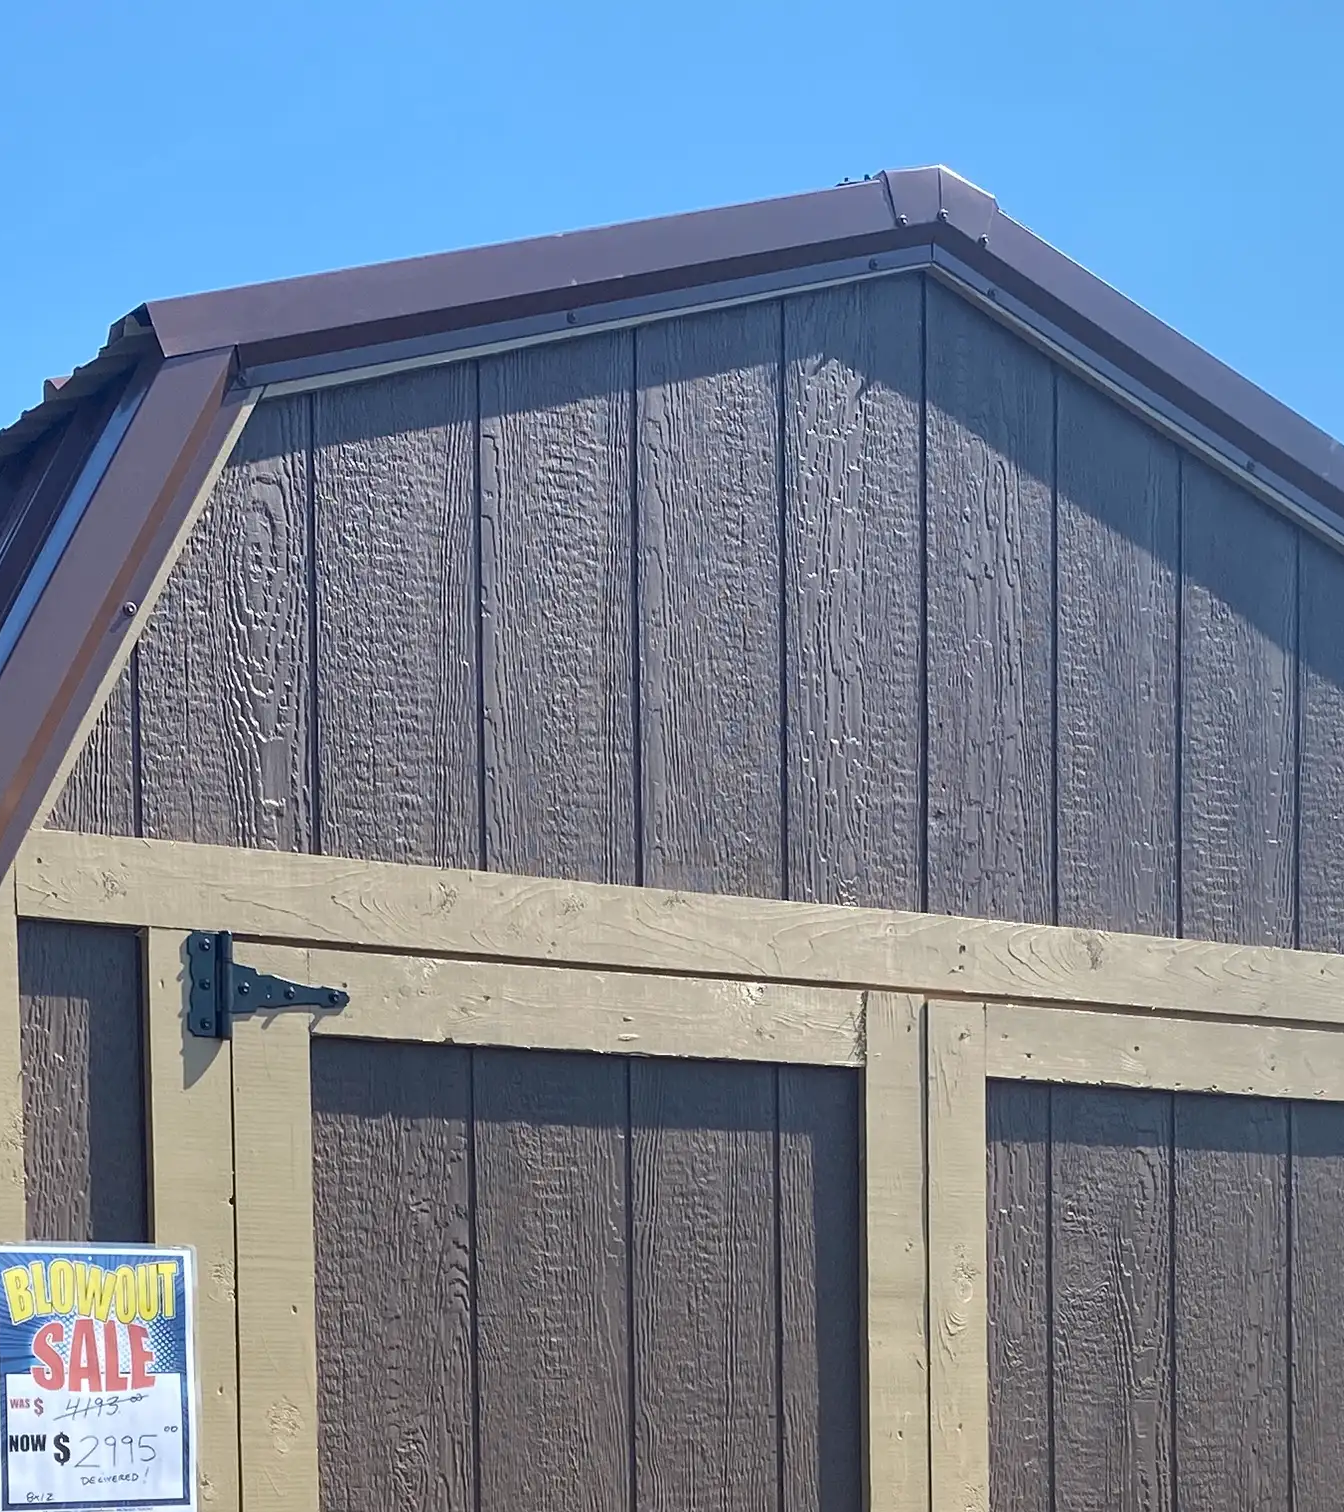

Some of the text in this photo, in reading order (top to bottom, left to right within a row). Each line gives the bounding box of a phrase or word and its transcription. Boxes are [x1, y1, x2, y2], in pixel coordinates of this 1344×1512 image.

[2, 1260, 178, 1324] BLOWOUT
[31, 1319, 156, 1392] SALE
[10, 1399, 30, 1409] WAS
[34, 1397, 44, 1417] $
[9, 1434, 47, 1453] NOW
[53, 1431, 71, 1467] $
[74, 1434, 159, 1468] 2995
